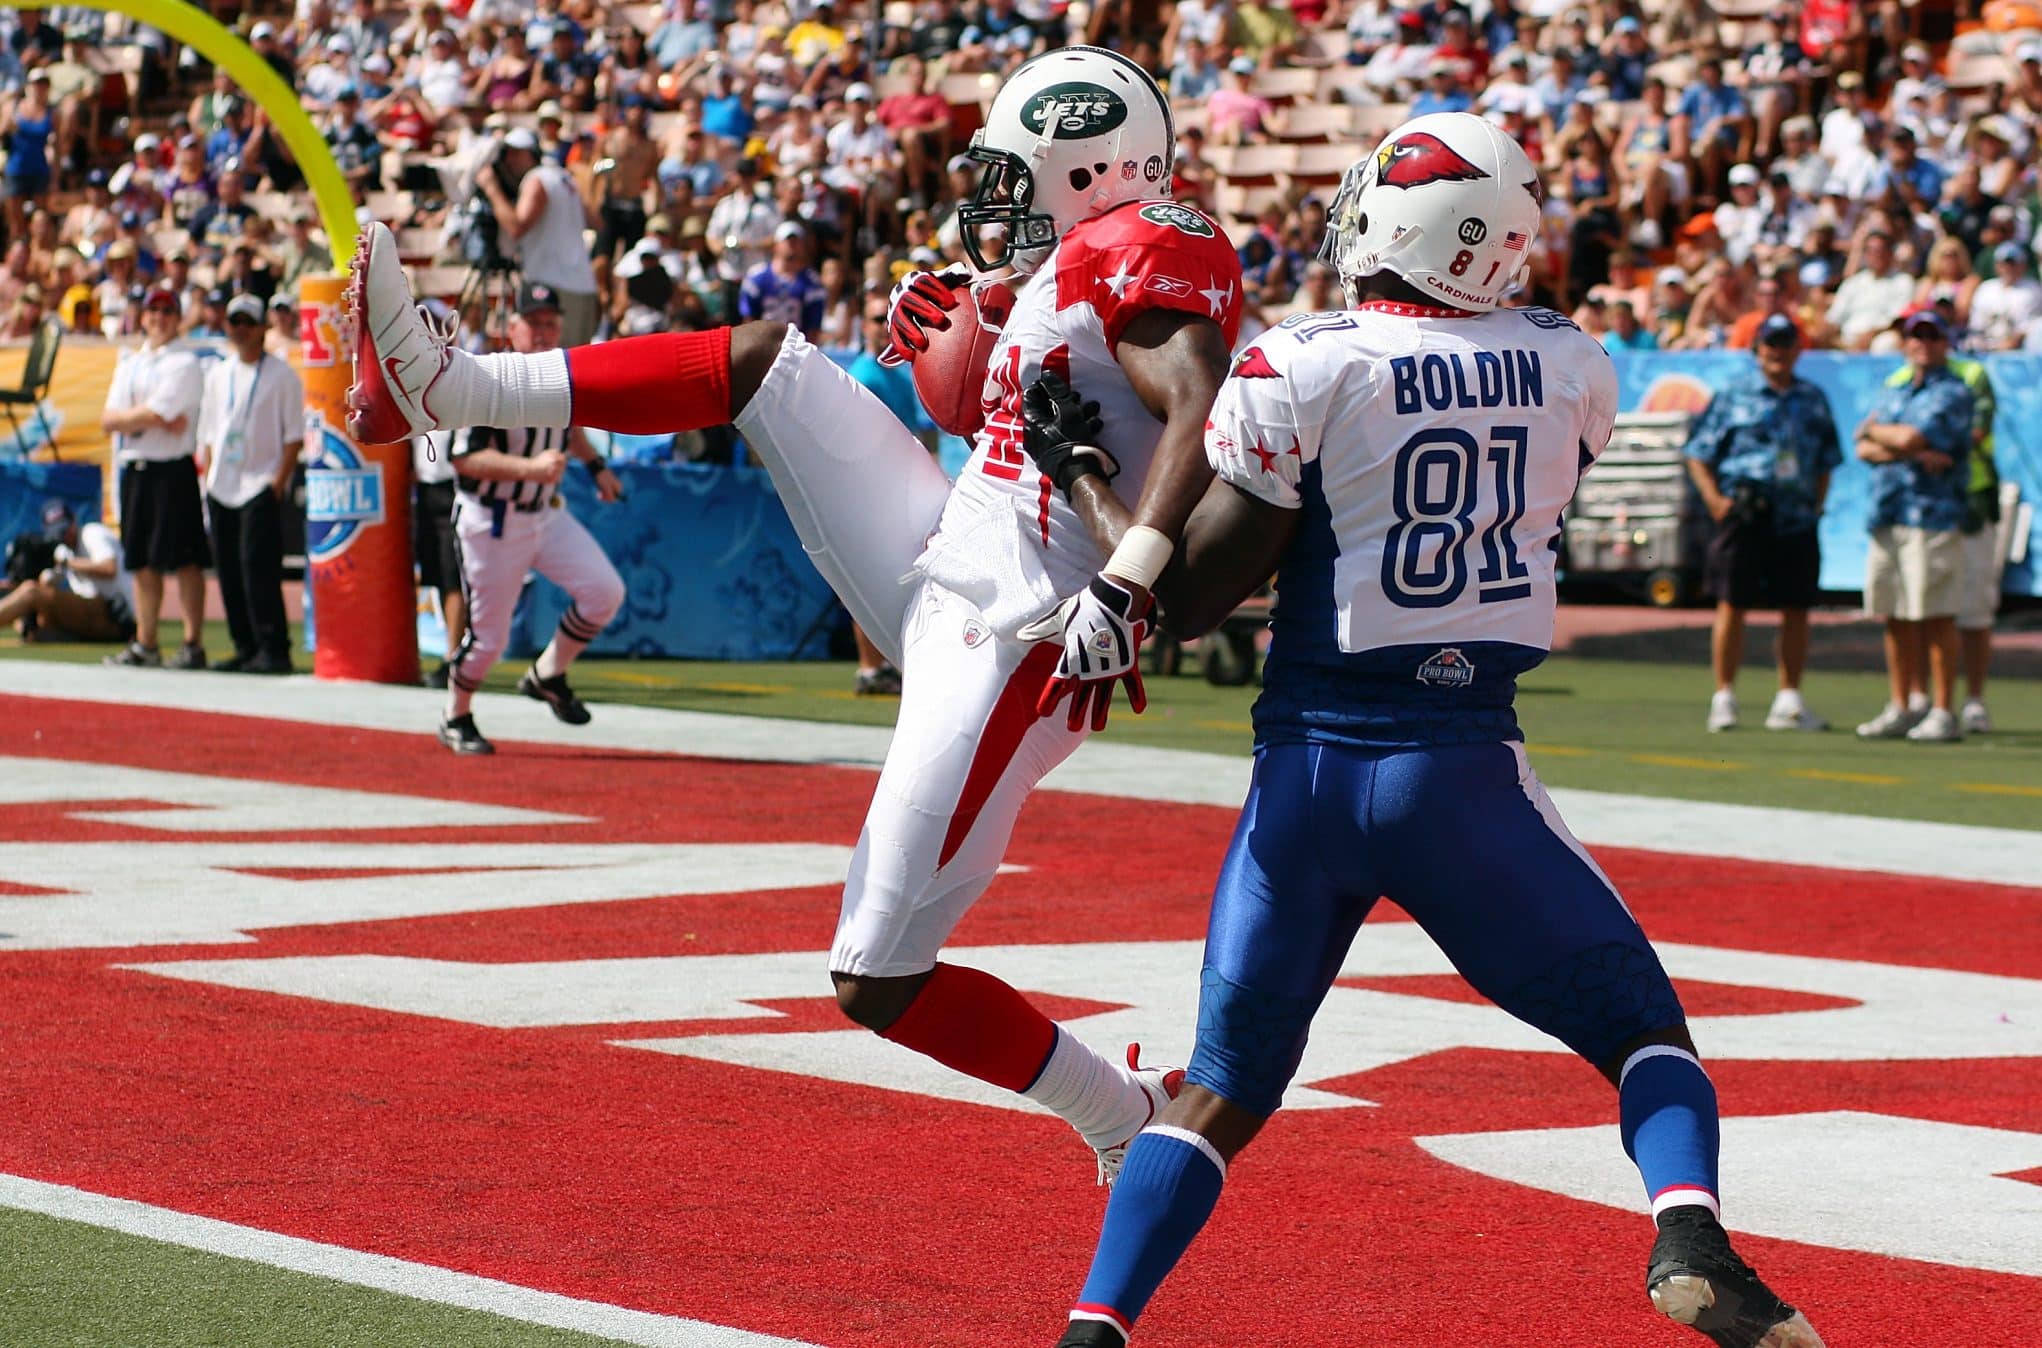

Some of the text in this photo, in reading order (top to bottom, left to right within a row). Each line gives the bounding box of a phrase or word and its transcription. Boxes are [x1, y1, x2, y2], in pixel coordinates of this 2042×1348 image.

[1033, 100, 1109, 121] JETS
[1146, 161, 1161, 177] GU
[1460, 221, 1484, 241] GU
[1427, 276, 1493, 304] CARDINALS
[1390, 350, 1543, 415] BOLDIN
[1381, 426, 1531, 608] 81
[1424, 667, 1468, 680] PRO BOWL
